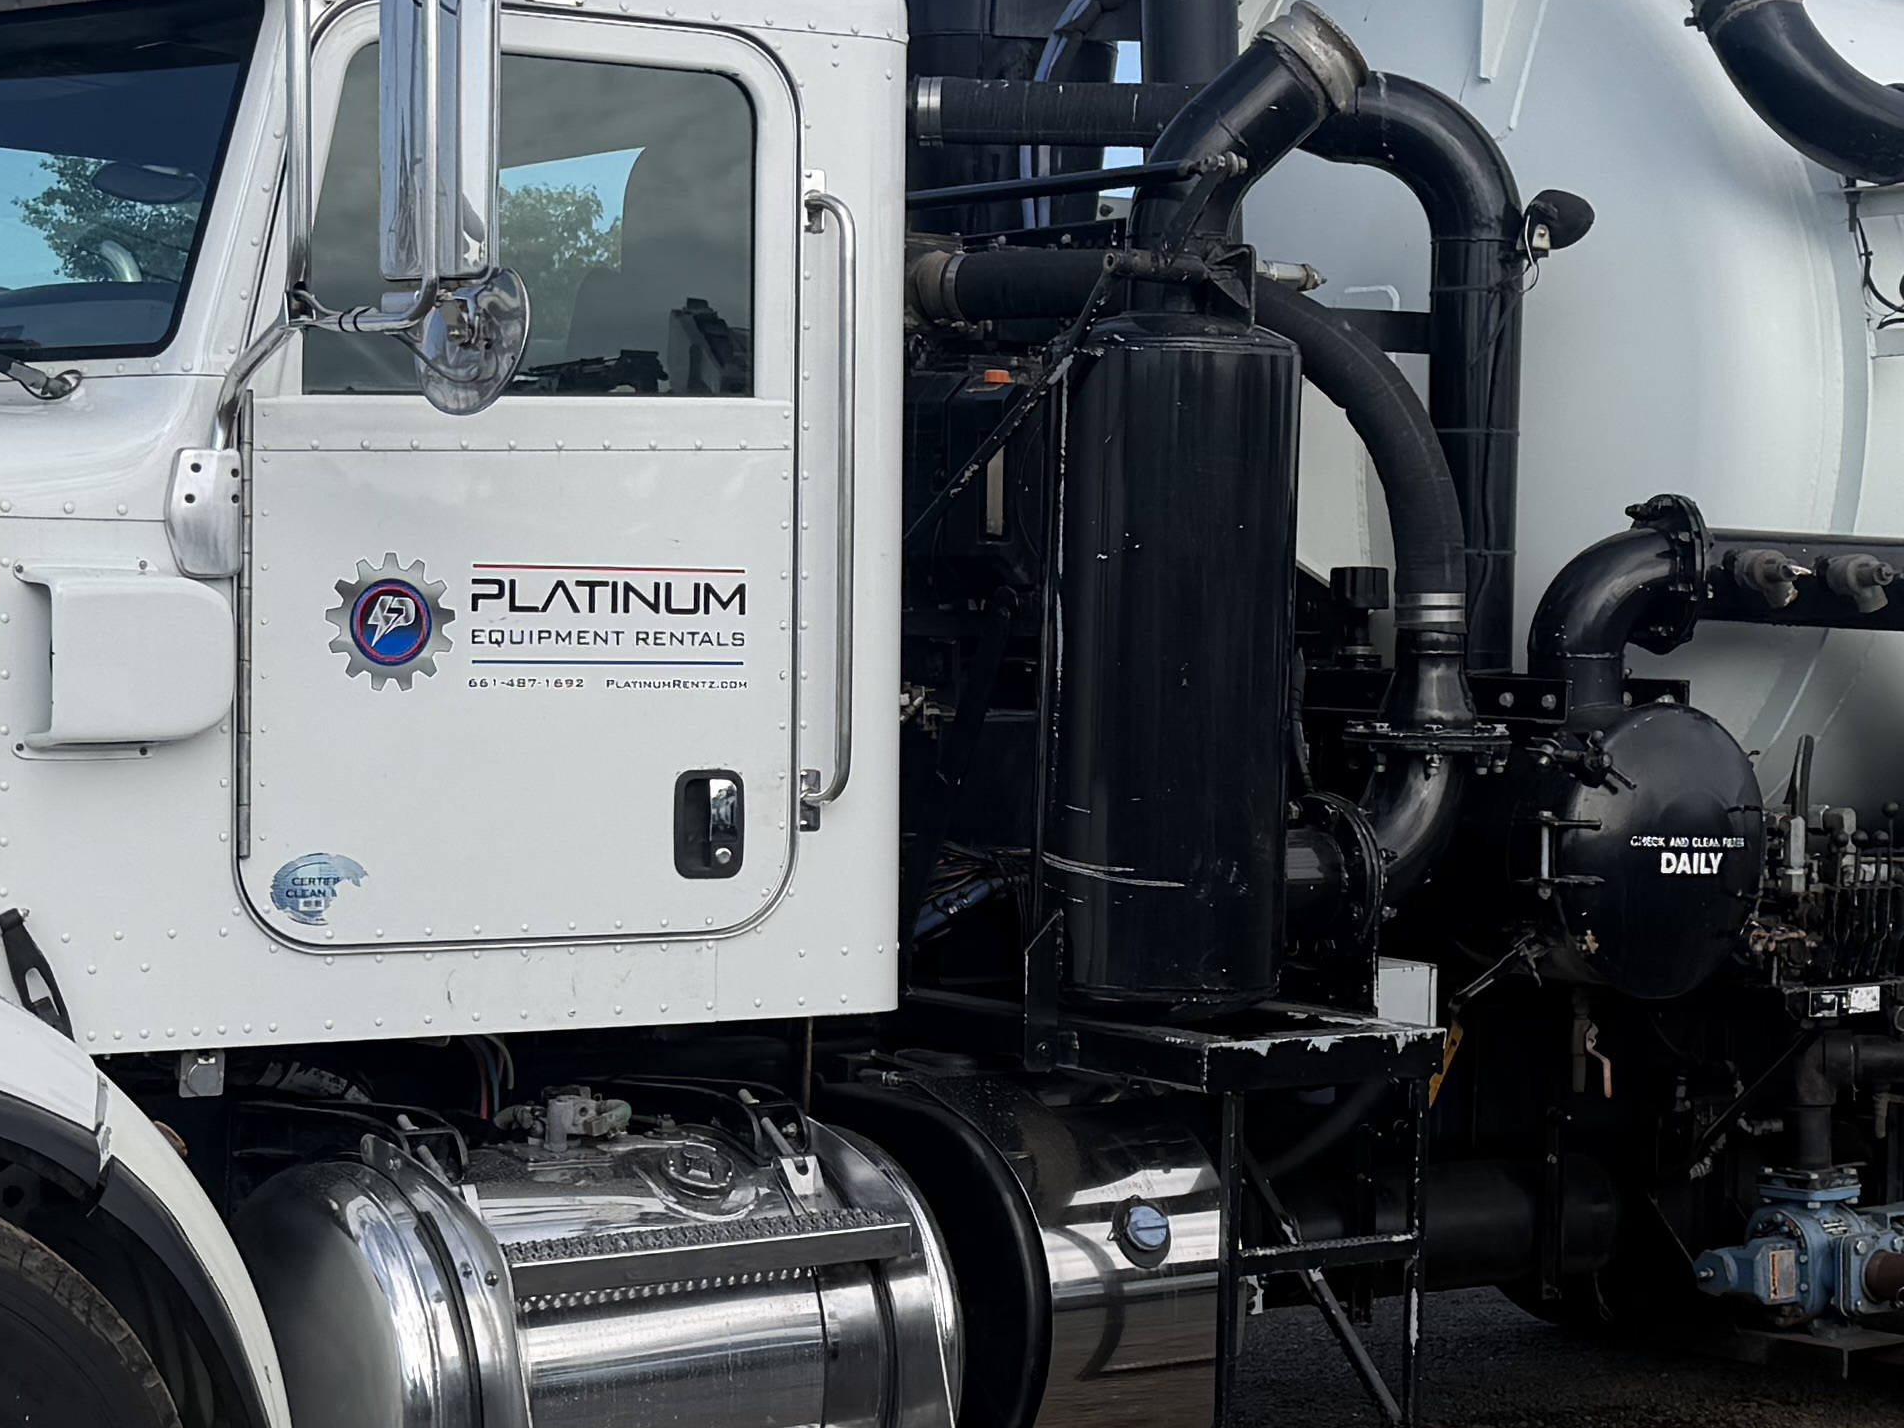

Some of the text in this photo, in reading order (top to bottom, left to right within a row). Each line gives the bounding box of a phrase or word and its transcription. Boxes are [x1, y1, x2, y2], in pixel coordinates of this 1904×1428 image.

[471, 578, 746, 615] PLATINUM
[471, 629, 745, 648] EQUIPMENT RENTALS
[1670, 836, 1689, 847] AND
[1661, 852, 1723, 874] DAILY
[285, 889, 326, 898] CLEAN
